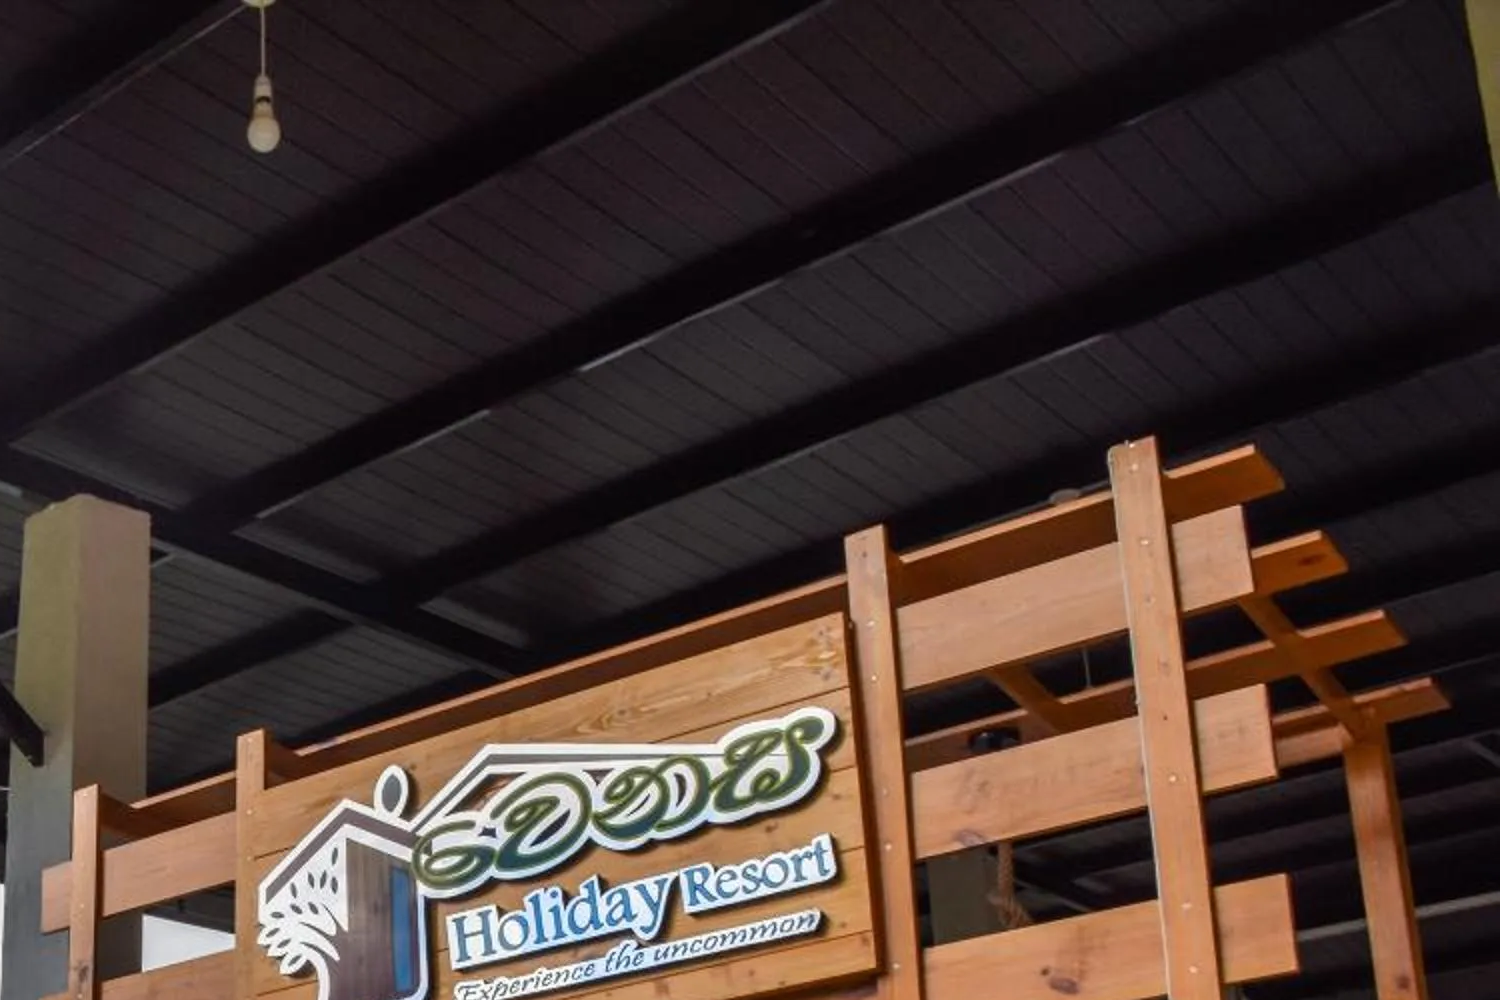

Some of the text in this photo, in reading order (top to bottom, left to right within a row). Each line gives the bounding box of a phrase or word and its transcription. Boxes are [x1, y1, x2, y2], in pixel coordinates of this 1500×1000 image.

[451, 844, 832, 964] Holiday Resort
[605, 944, 645, 972] the
[655, 911, 817, 963] uncommon
